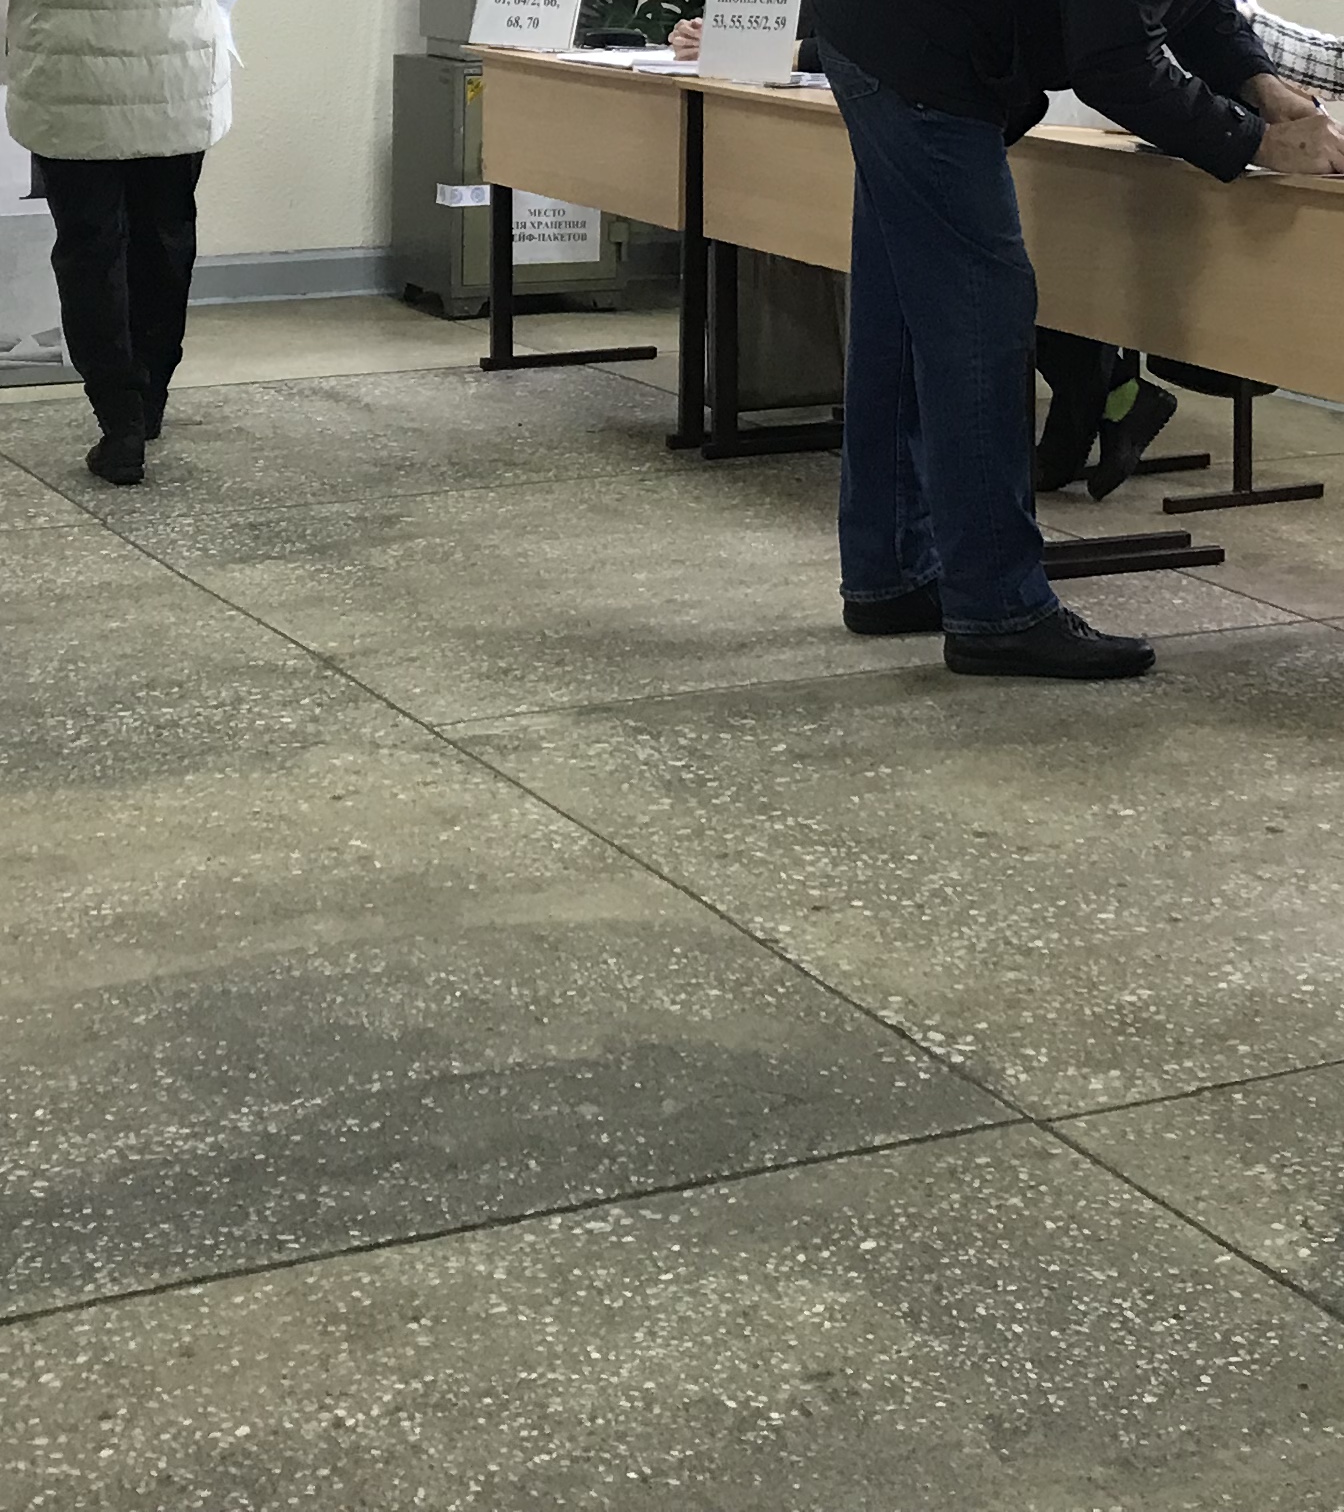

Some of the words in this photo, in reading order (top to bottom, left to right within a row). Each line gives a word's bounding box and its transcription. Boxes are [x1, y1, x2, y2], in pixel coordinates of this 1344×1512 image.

[506, 17, 523, 30] 68,
[527, 17, 540, 29] 70
[712, 14, 728, 31] 53,
[730, 15, 745, 31] 55,
[747, 15, 771, 32] 55/2,
[773, 16, 787, 31] 59
[528, 209, 566, 218] МЕСТО
[513, 221, 527, 230] ЛЯ
[529, 220, 587, 230] ХРАНЕНИЯ
